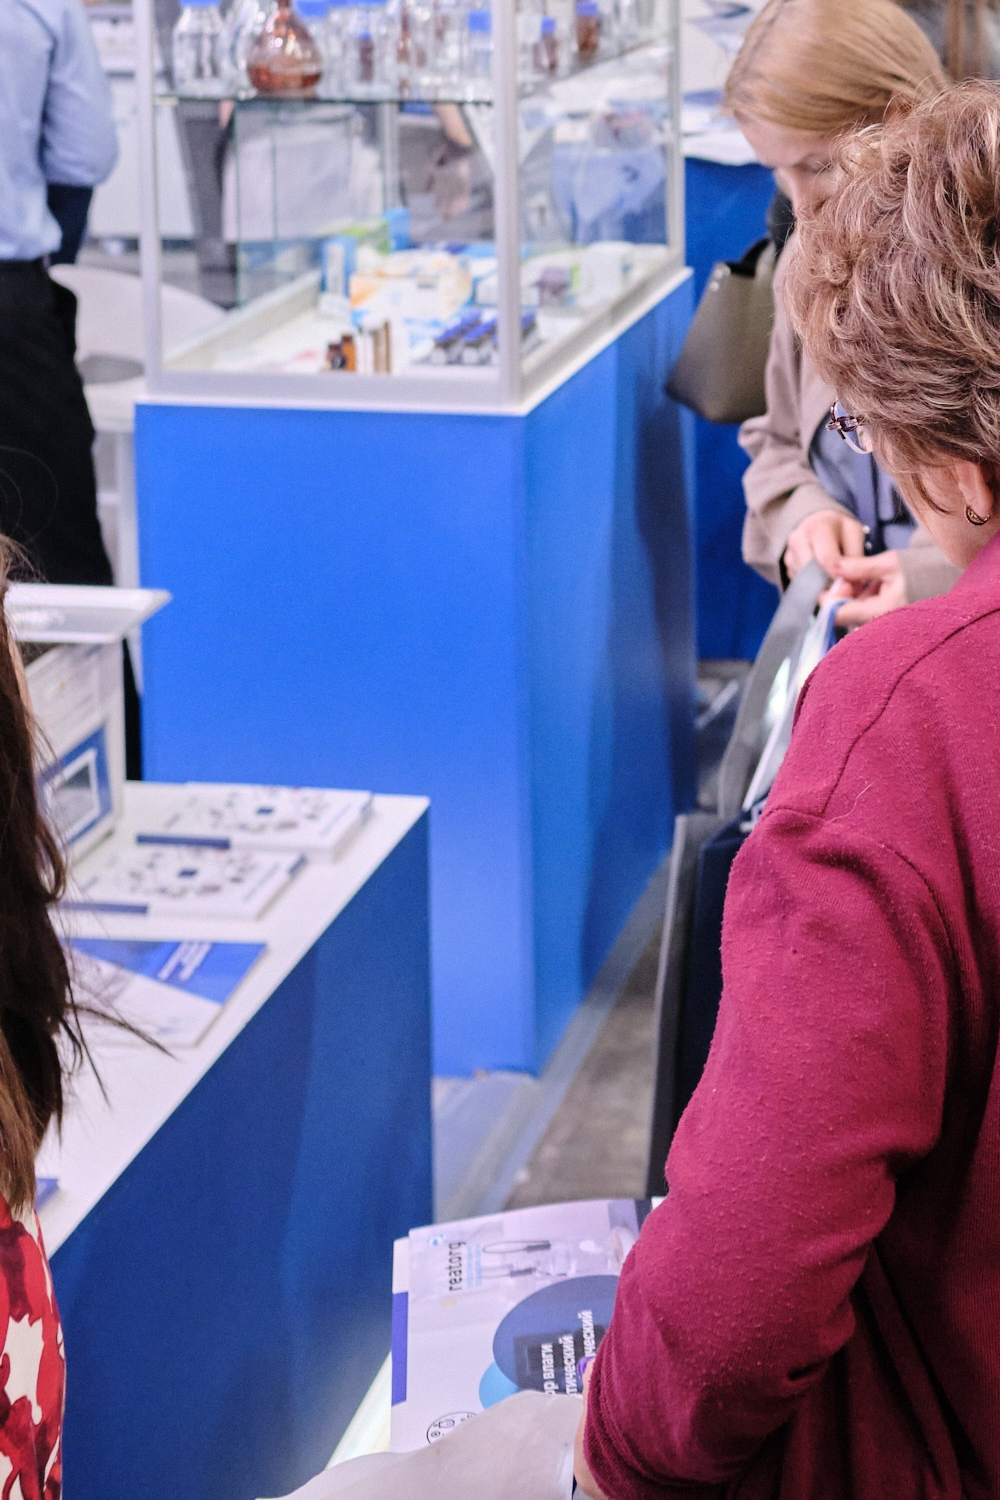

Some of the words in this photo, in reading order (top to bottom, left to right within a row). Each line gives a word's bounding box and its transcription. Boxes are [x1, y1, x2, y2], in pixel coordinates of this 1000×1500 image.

[448, 1242, 466, 1291] reatorg
[541, 1344, 555, 1380] влаги
[558, 1335, 578, 1396] тический
